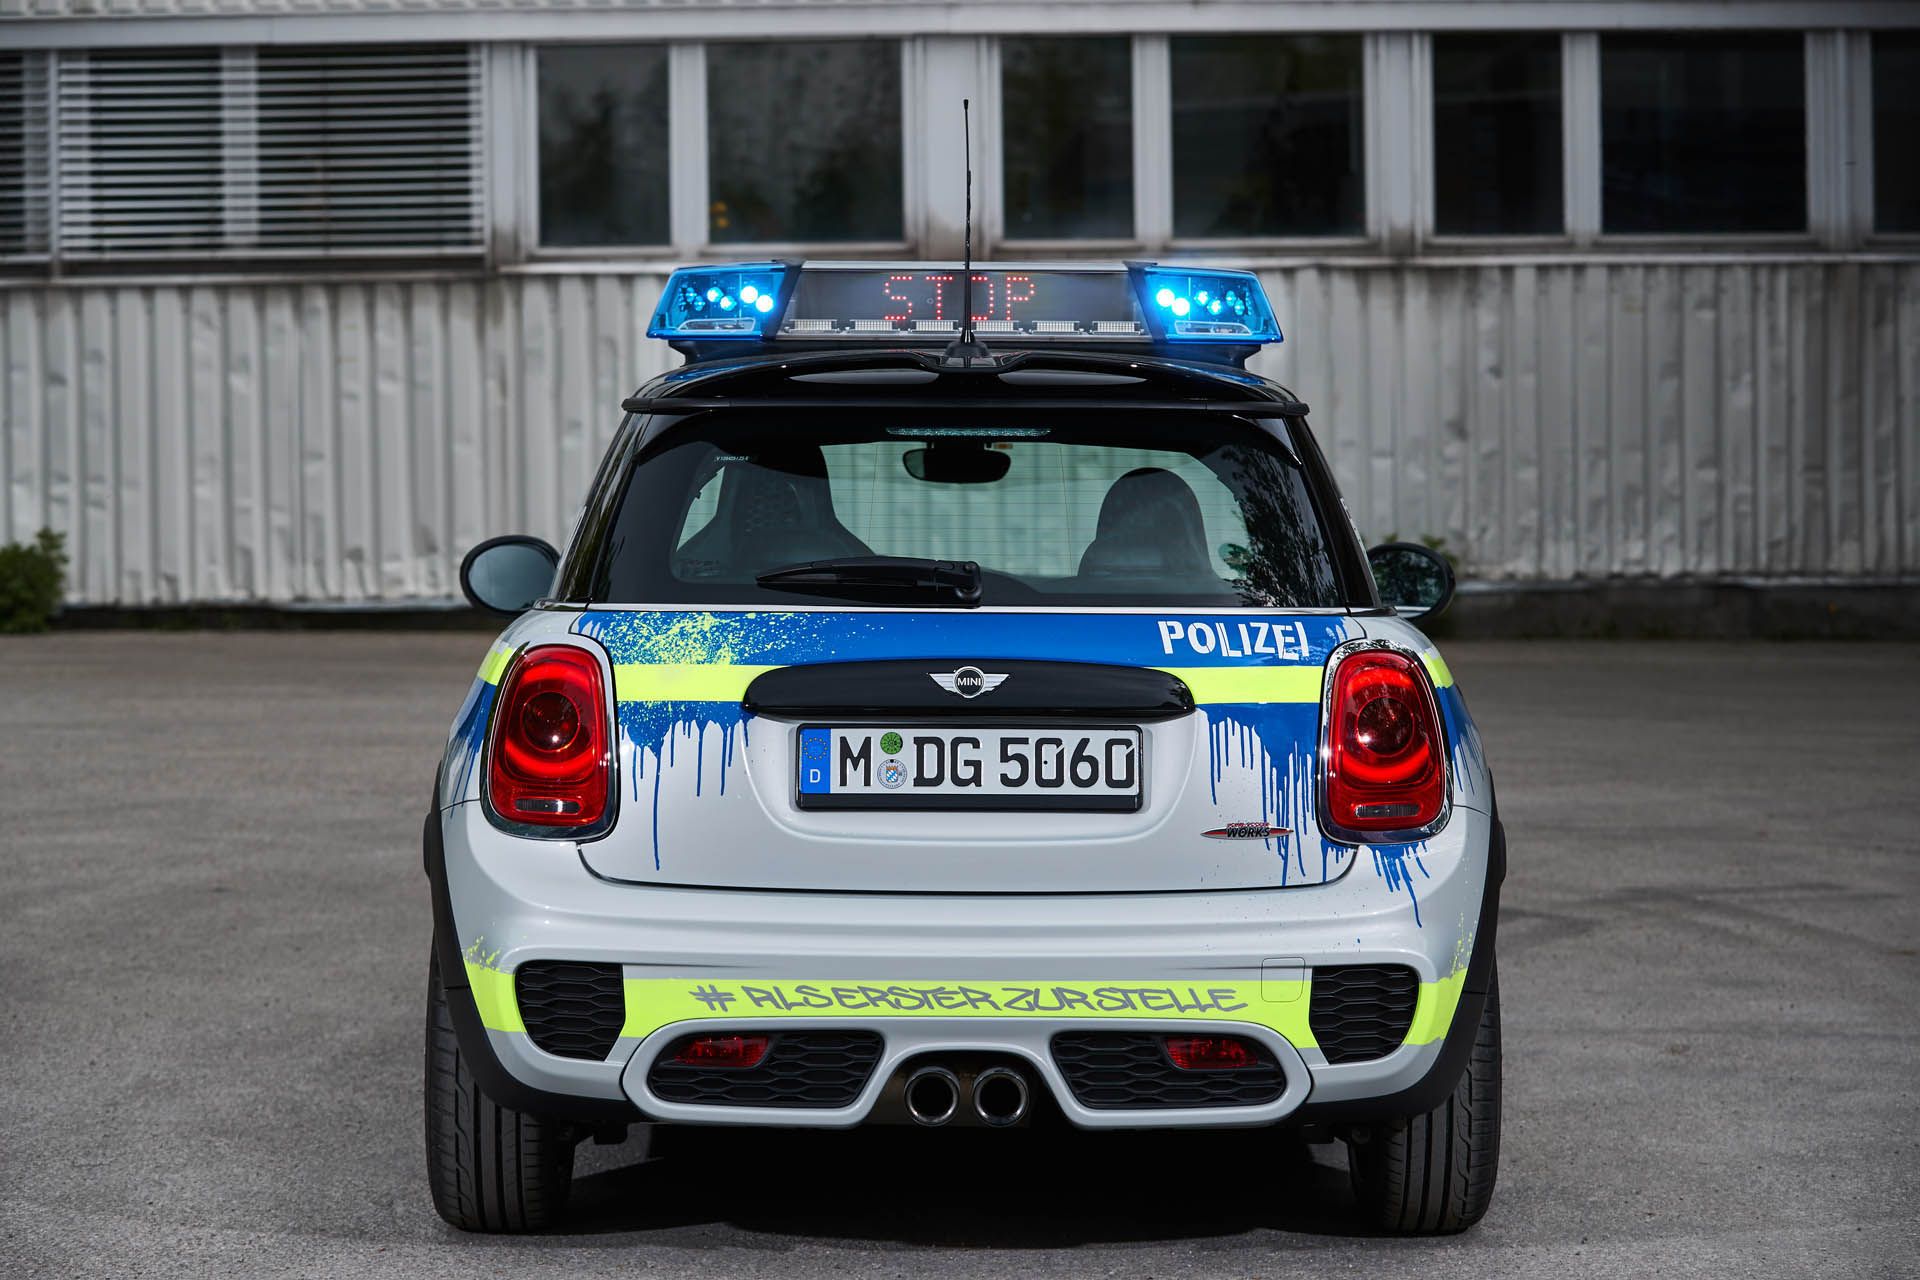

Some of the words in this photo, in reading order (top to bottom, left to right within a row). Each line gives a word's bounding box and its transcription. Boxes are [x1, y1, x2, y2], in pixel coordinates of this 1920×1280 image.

[884, 275, 1035, 321] STOP
[1157, 620, 1310, 661] POLIZEI
[957, 677, 981, 686] MINI
[809, 768, 821, 783] D
[839, 736, 872, 787] M
[913, 736, 982, 787] DG
[1000, 737, 1136, 788] 5060
[1226, 826, 1271, 838] WORKS
